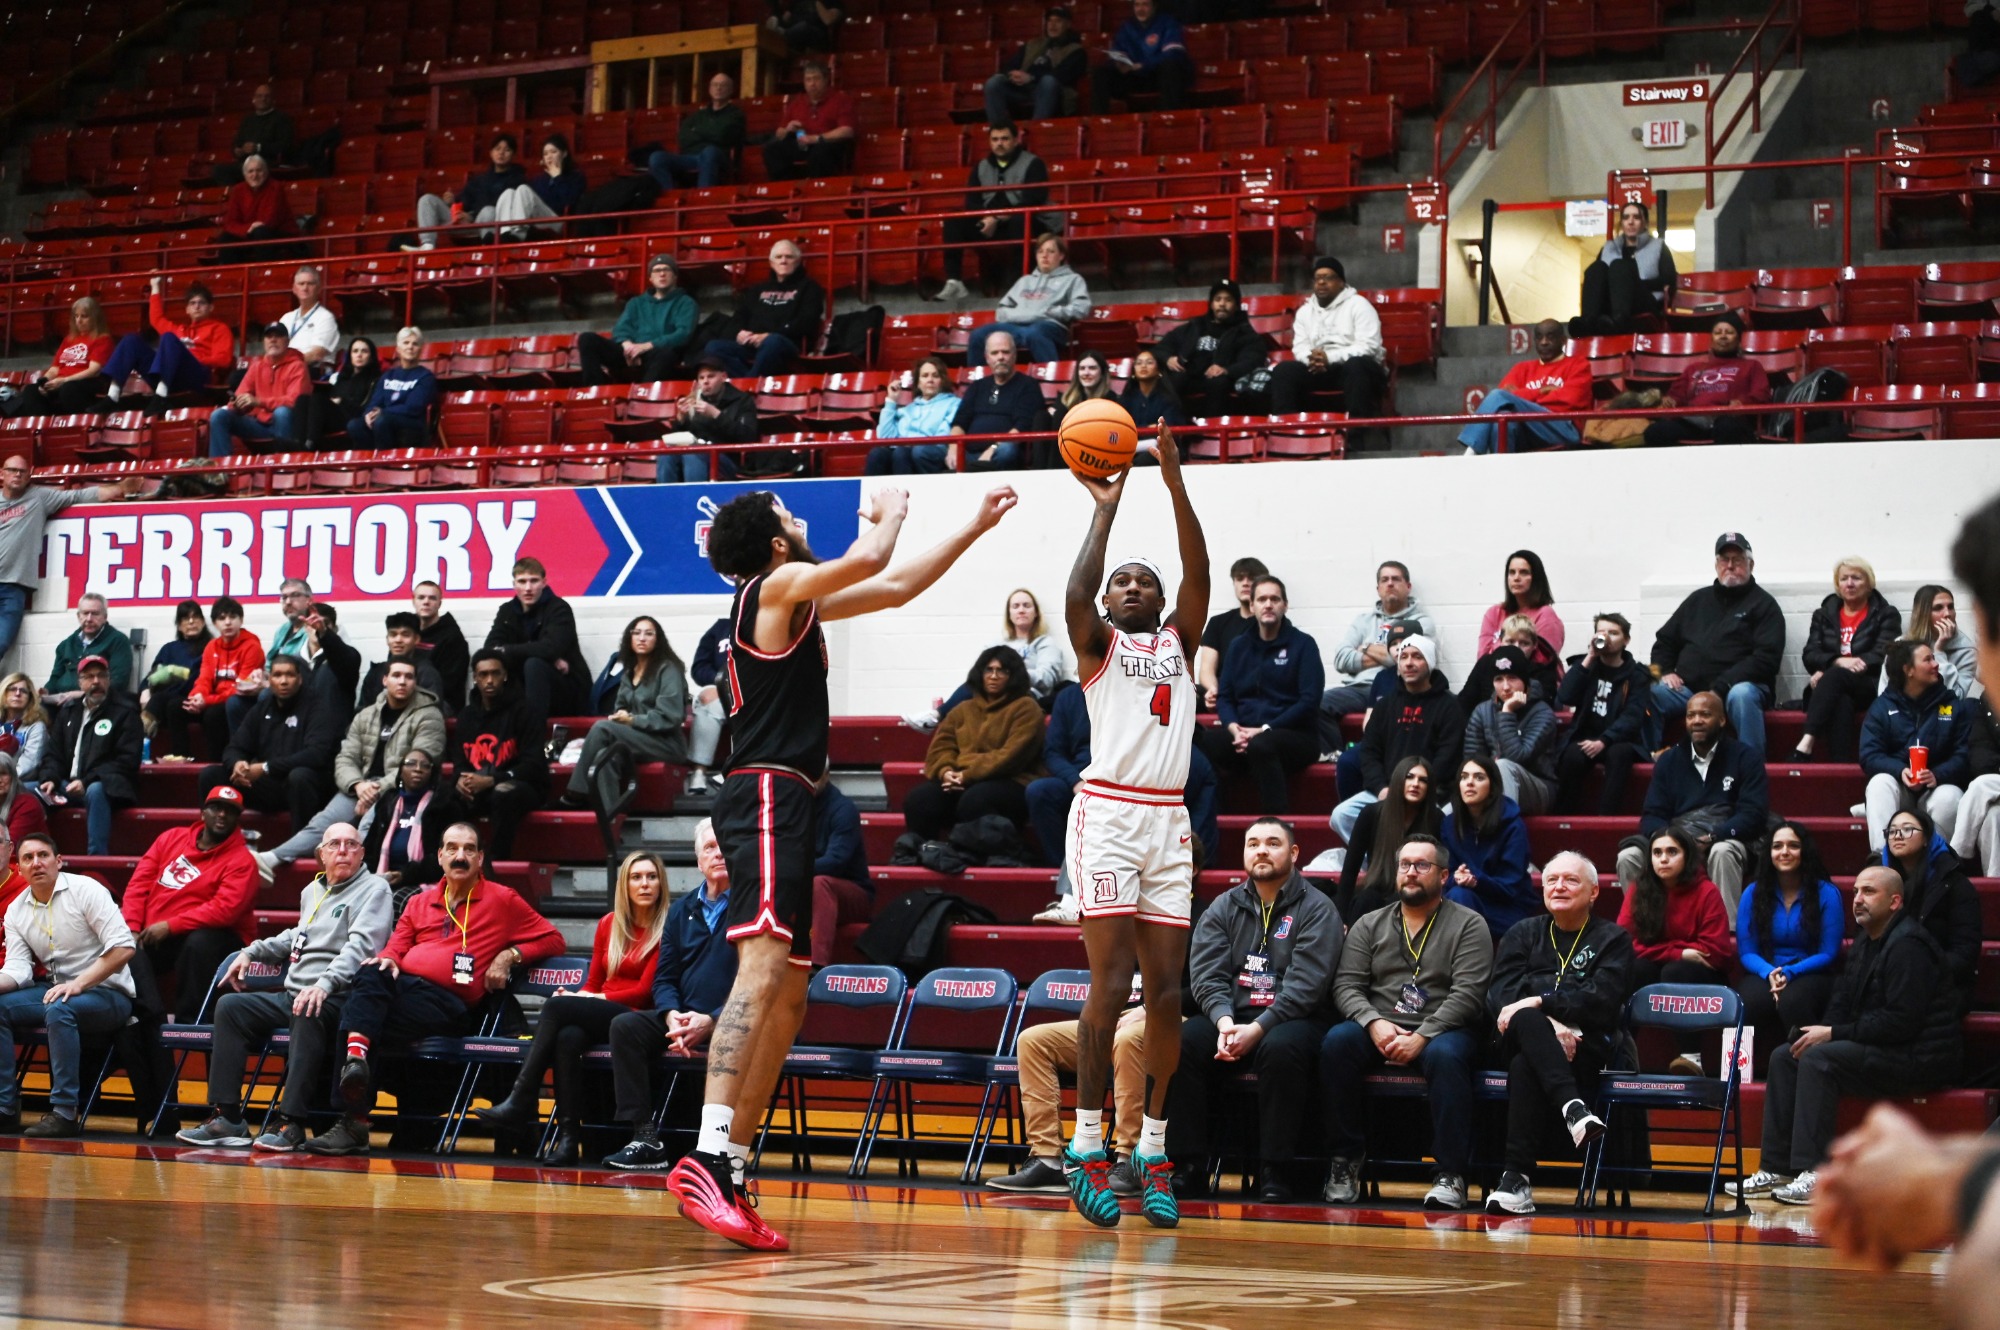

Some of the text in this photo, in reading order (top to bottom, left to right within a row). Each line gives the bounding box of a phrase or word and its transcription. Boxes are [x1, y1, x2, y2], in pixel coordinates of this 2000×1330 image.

[1630, 84, 1703, 101] Stairway 9
[1650, 120, 1680, 145] EXIT
[1894, 141, 1920, 154] SECTION
[1624, 190, 1642, 204] 13
[1415, 203, 1432, 218] 12
[1376, 295, 1389, 304] 31
[1094, 310, 1110, 318] 27
[1162, 306, 1178, 316] 28
[957, 316, 973, 326] 25
[1510, 328, 1529, 354] D
[58, 420, 67, 428] 11
[111, 417, 123, 425] 12
[1079, 450, 1127, 471] Wilson
[42, 500, 537, 601] TERRITORY
[1120, 655, 1183, 681] TITANS
[1149, 683, 1172, 727] 4
[245, 961, 282, 978] TANS
[528, 968, 583, 986] TITANS
[826, 975, 889, 994] TITANS
[934, 979, 996, 998] TITANS
[1046, 982, 1091, 1001] TITA
[1649, 994, 1724, 1014] TITANS
[1642, 1082, 1668, 1090] COLLEGE
[1667, 1083, 1686, 1091] TEAM
